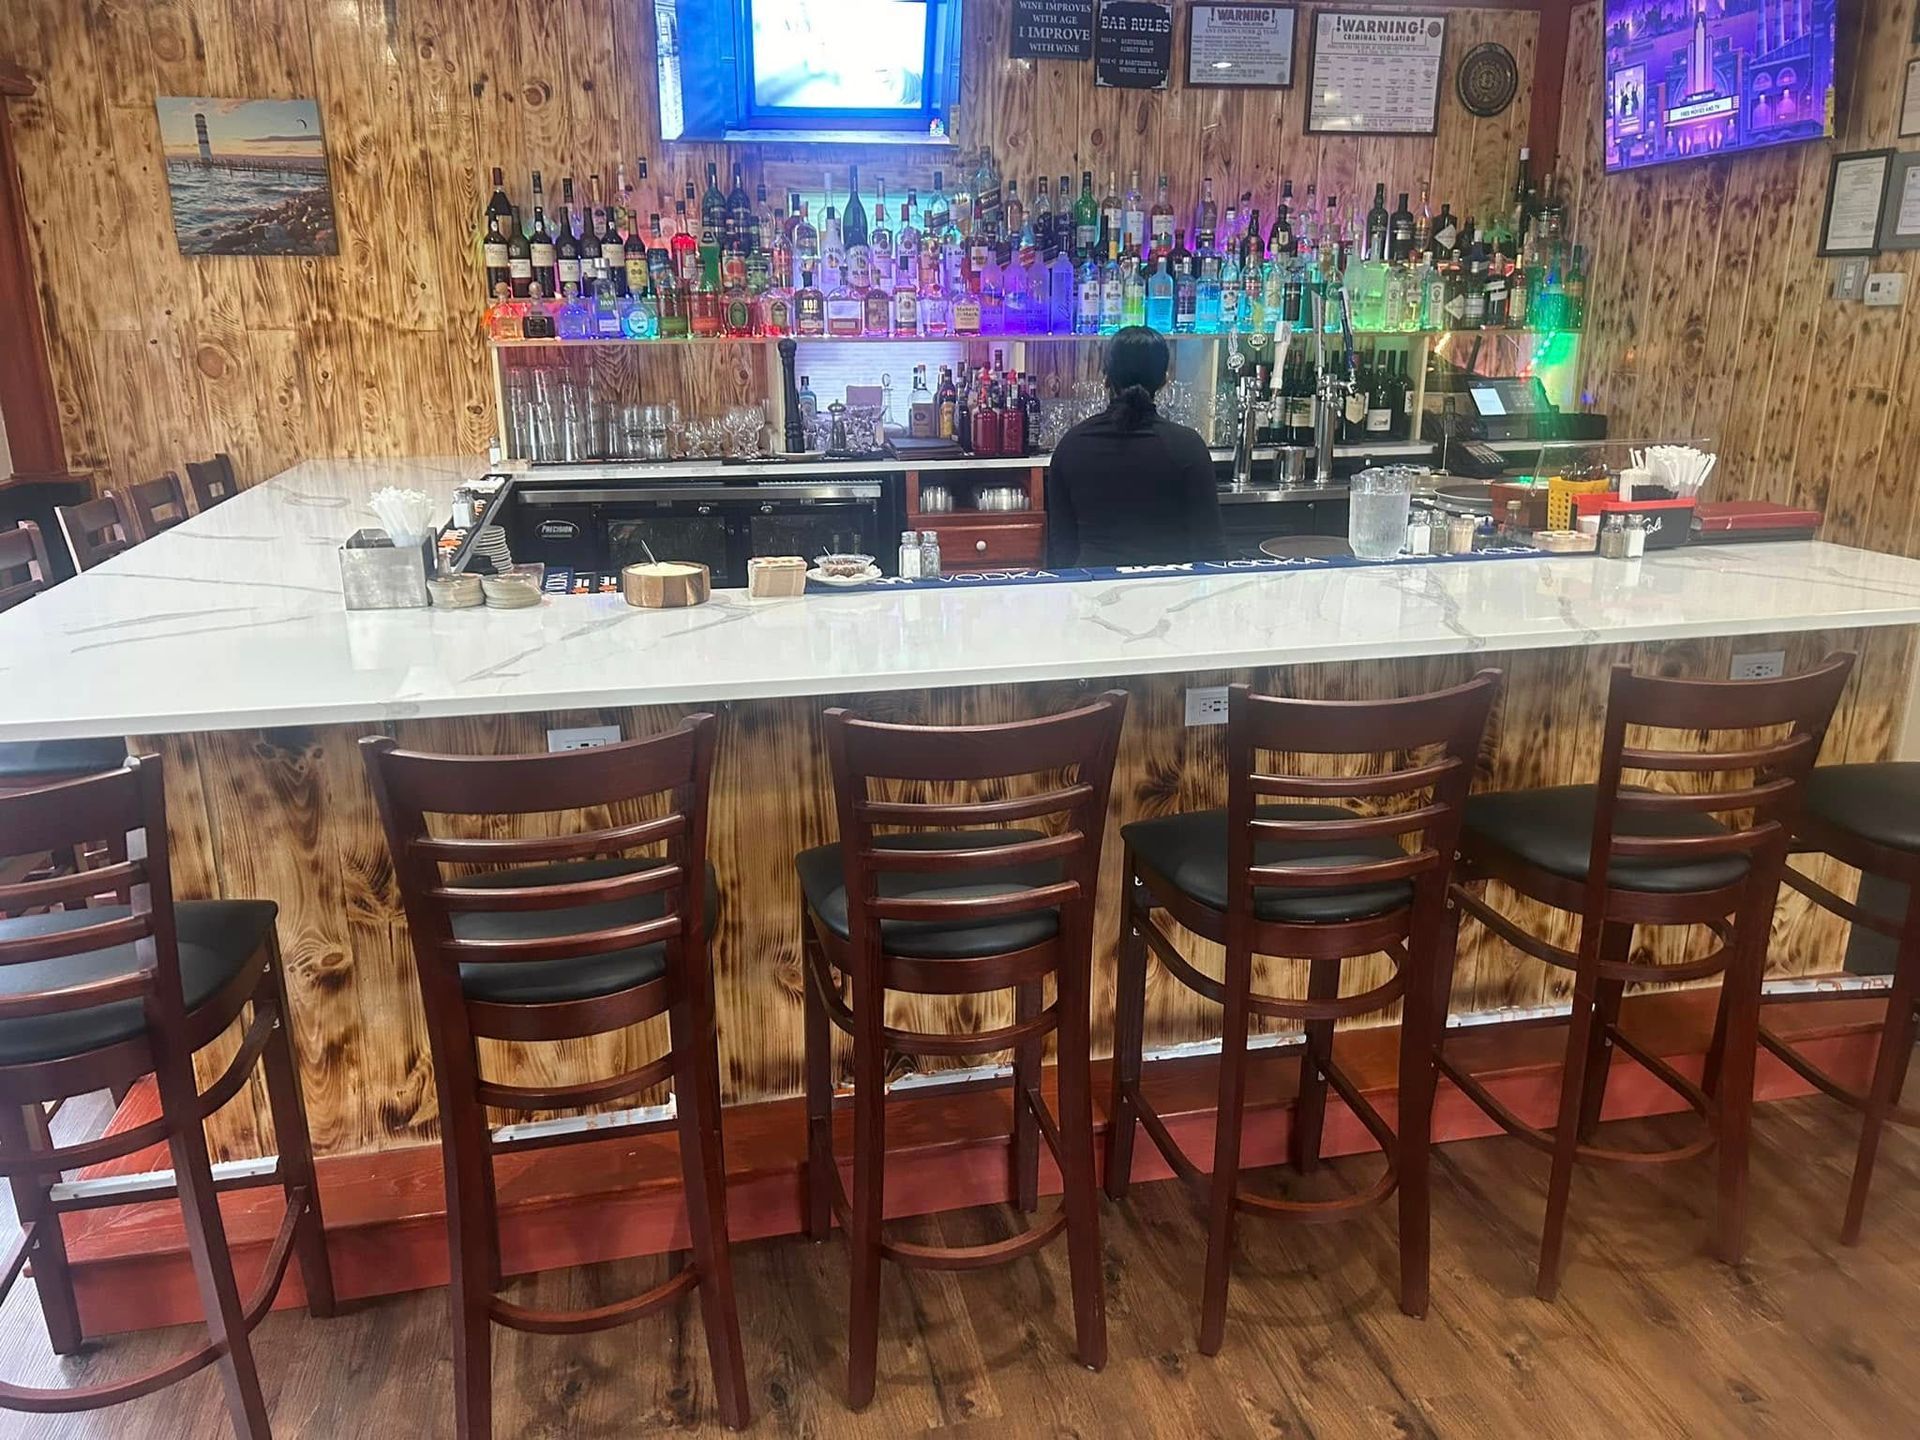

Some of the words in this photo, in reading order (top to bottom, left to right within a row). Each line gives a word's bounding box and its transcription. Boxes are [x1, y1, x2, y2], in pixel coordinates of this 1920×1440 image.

[1019, 1, 1043, 10] WINE
[1045, 2, 1091, 13] IMPROVES
[1033, 14, 1057, 23] WITH
[1060, 16, 1078, 25] AGE
[1101, 16, 1127, 30] BAR
[1131, 17, 1169, 33] RULES
[1019, 26, 1024, 38] I
[1028, 26, 1090, 41] IMPROVE
[1343, 33, 1376, 41] CRIMINAL
[1380, 34, 1416, 42] VIOLATION
[1029, 42, 1054, 52] WITH
[1055, 44, 1080, 53] WINE
[541, 525, 573, 533] PRECISION
[1203, 557, 1329, 569] VODKA
[938, 571, 1060, 582] VODKA
